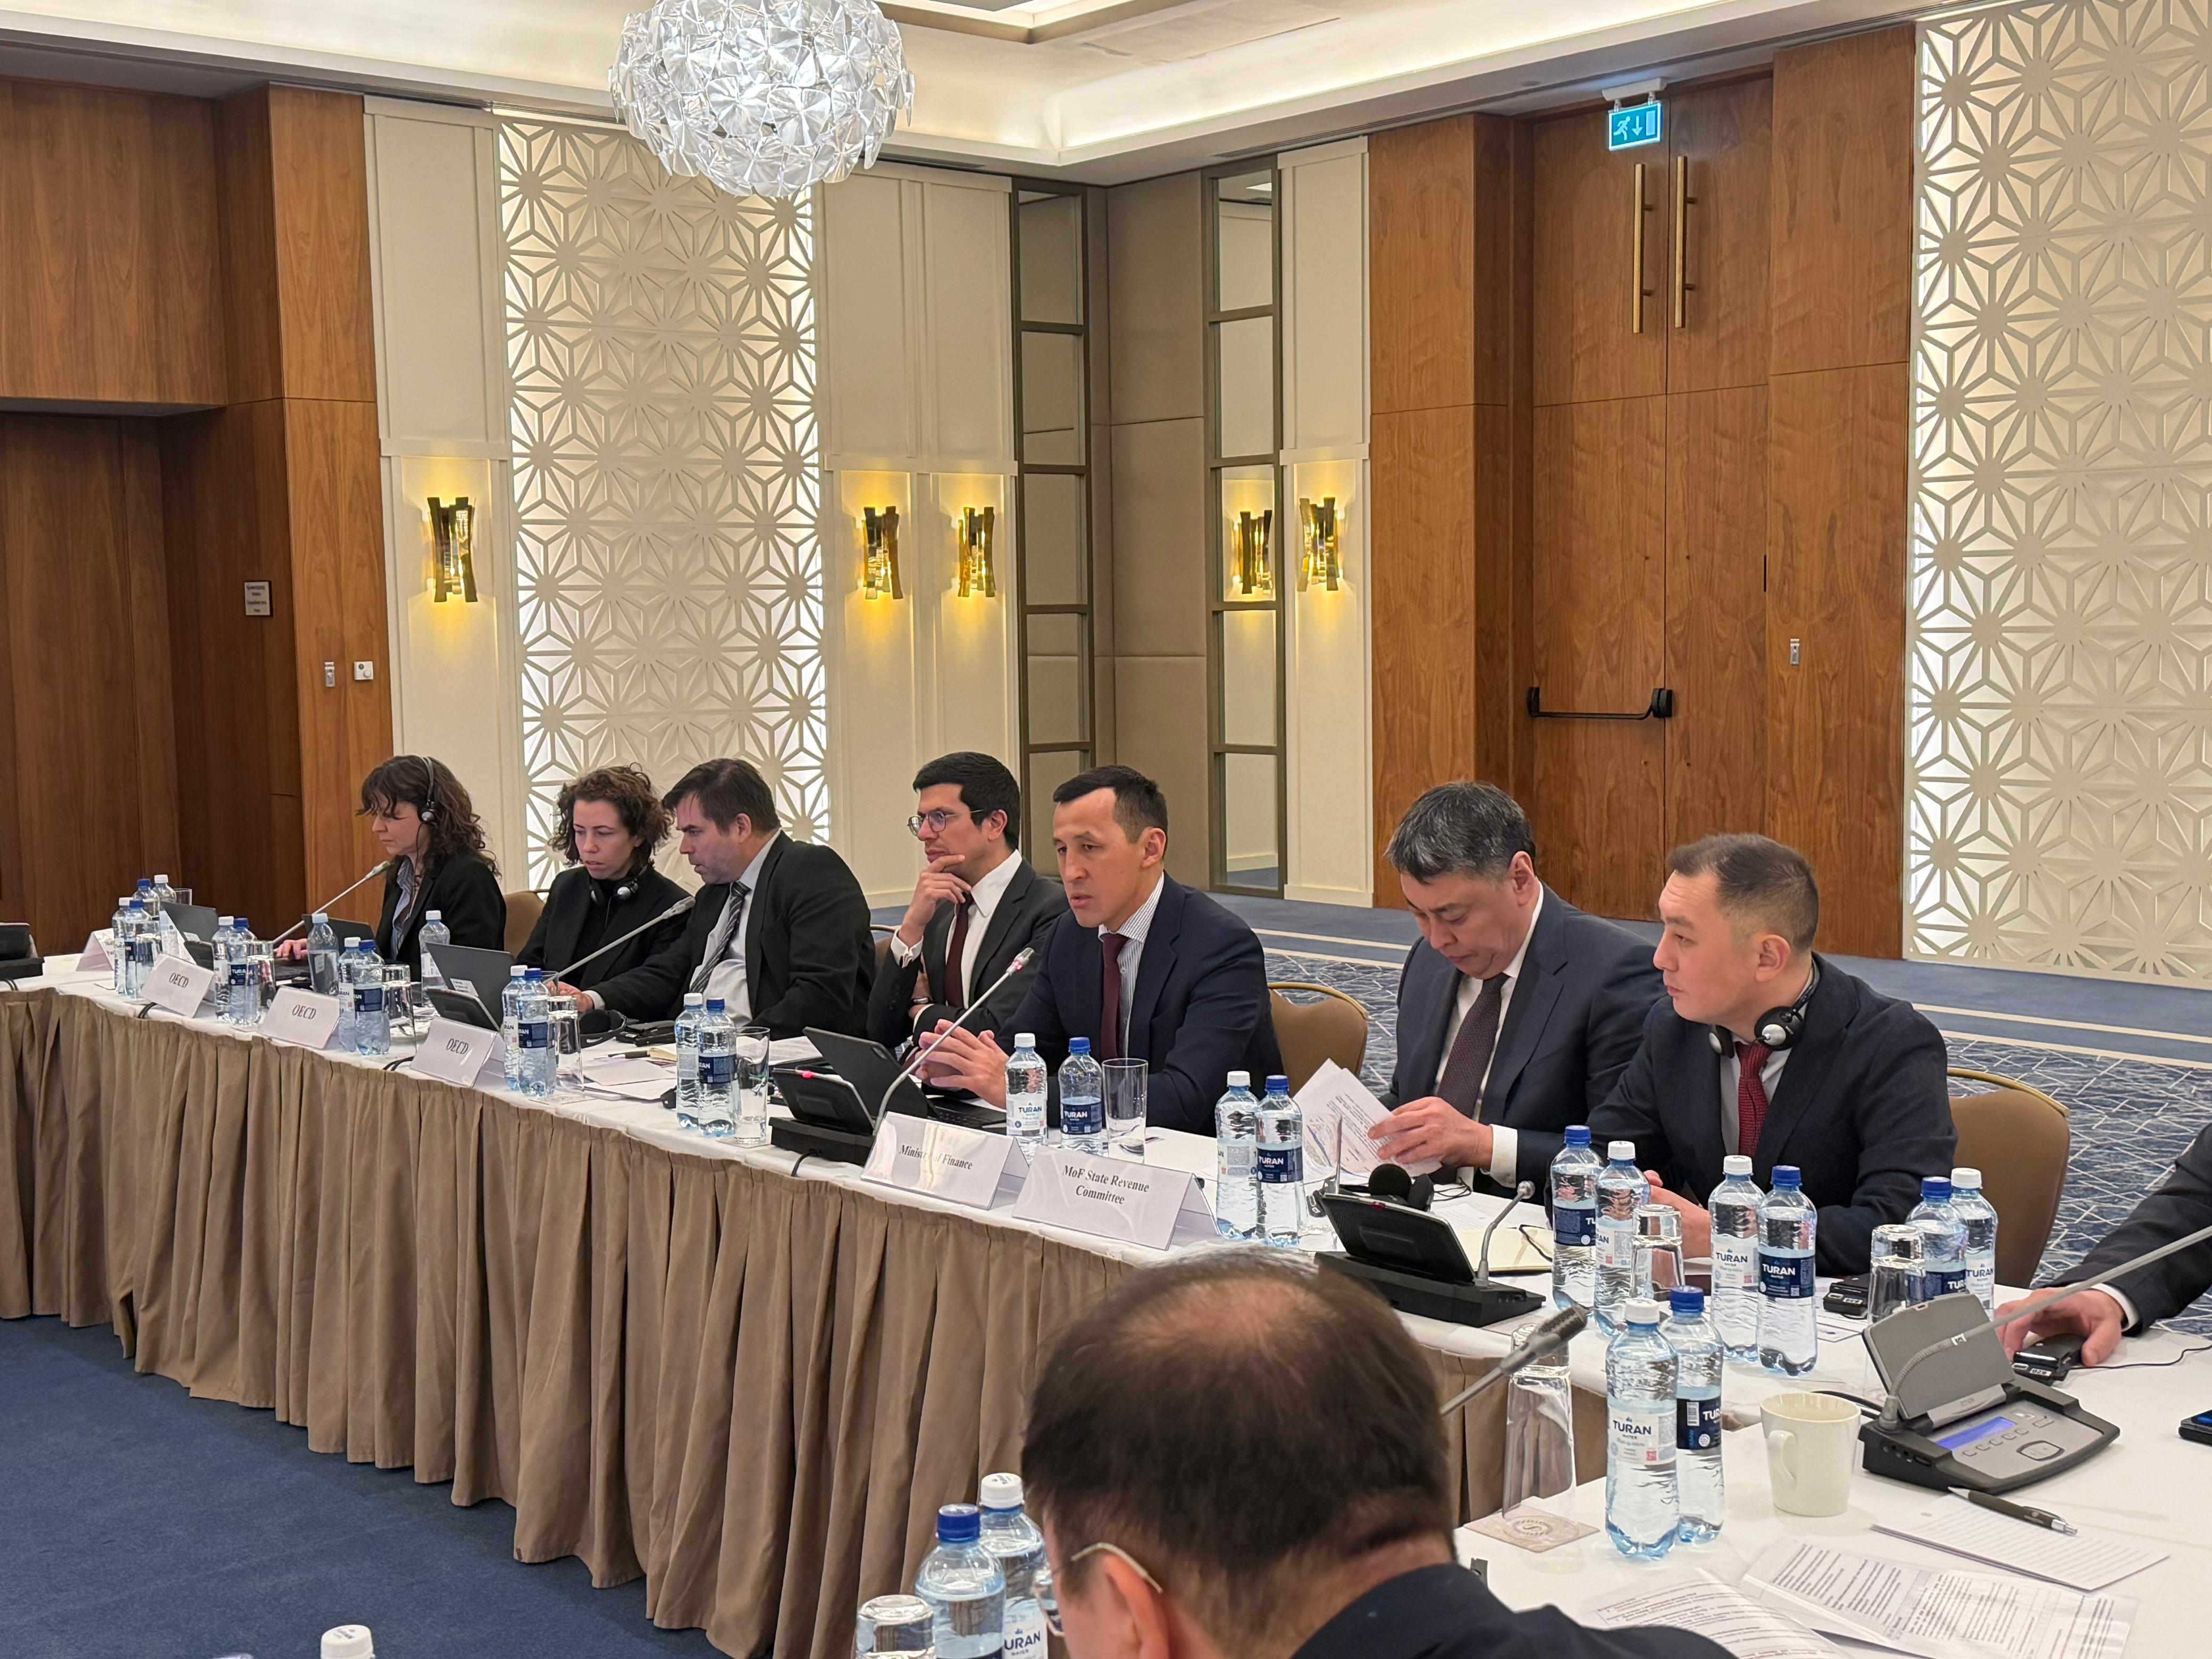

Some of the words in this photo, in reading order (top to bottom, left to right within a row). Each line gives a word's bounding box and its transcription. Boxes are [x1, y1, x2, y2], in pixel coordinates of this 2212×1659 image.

[169, 973, 189, 988] OECD
[292, 1004, 316, 1019] OECD
[446, 1038, 469, 1054] OECD
[942, 1154, 973, 1170] Finance
[1258, 1156, 1284, 1165] TURAN
[1062, 1165, 1085, 1178] MoF
[1085, 1170, 1109, 1184] State
[1110, 1175, 1150, 1192] Revenue
[1076, 1185, 1125, 1204] Committee
[1716, 1252, 1748, 1263] TURAN
[1762, 1263, 1796, 1276] TURAN
[1966, 1268, 1993, 1277] TURAN
[1947, 1279, 1965, 1289] TUR
[1613, 1420, 1652, 1435] TURAN
[1004, 1630, 1041, 1650] URAN
